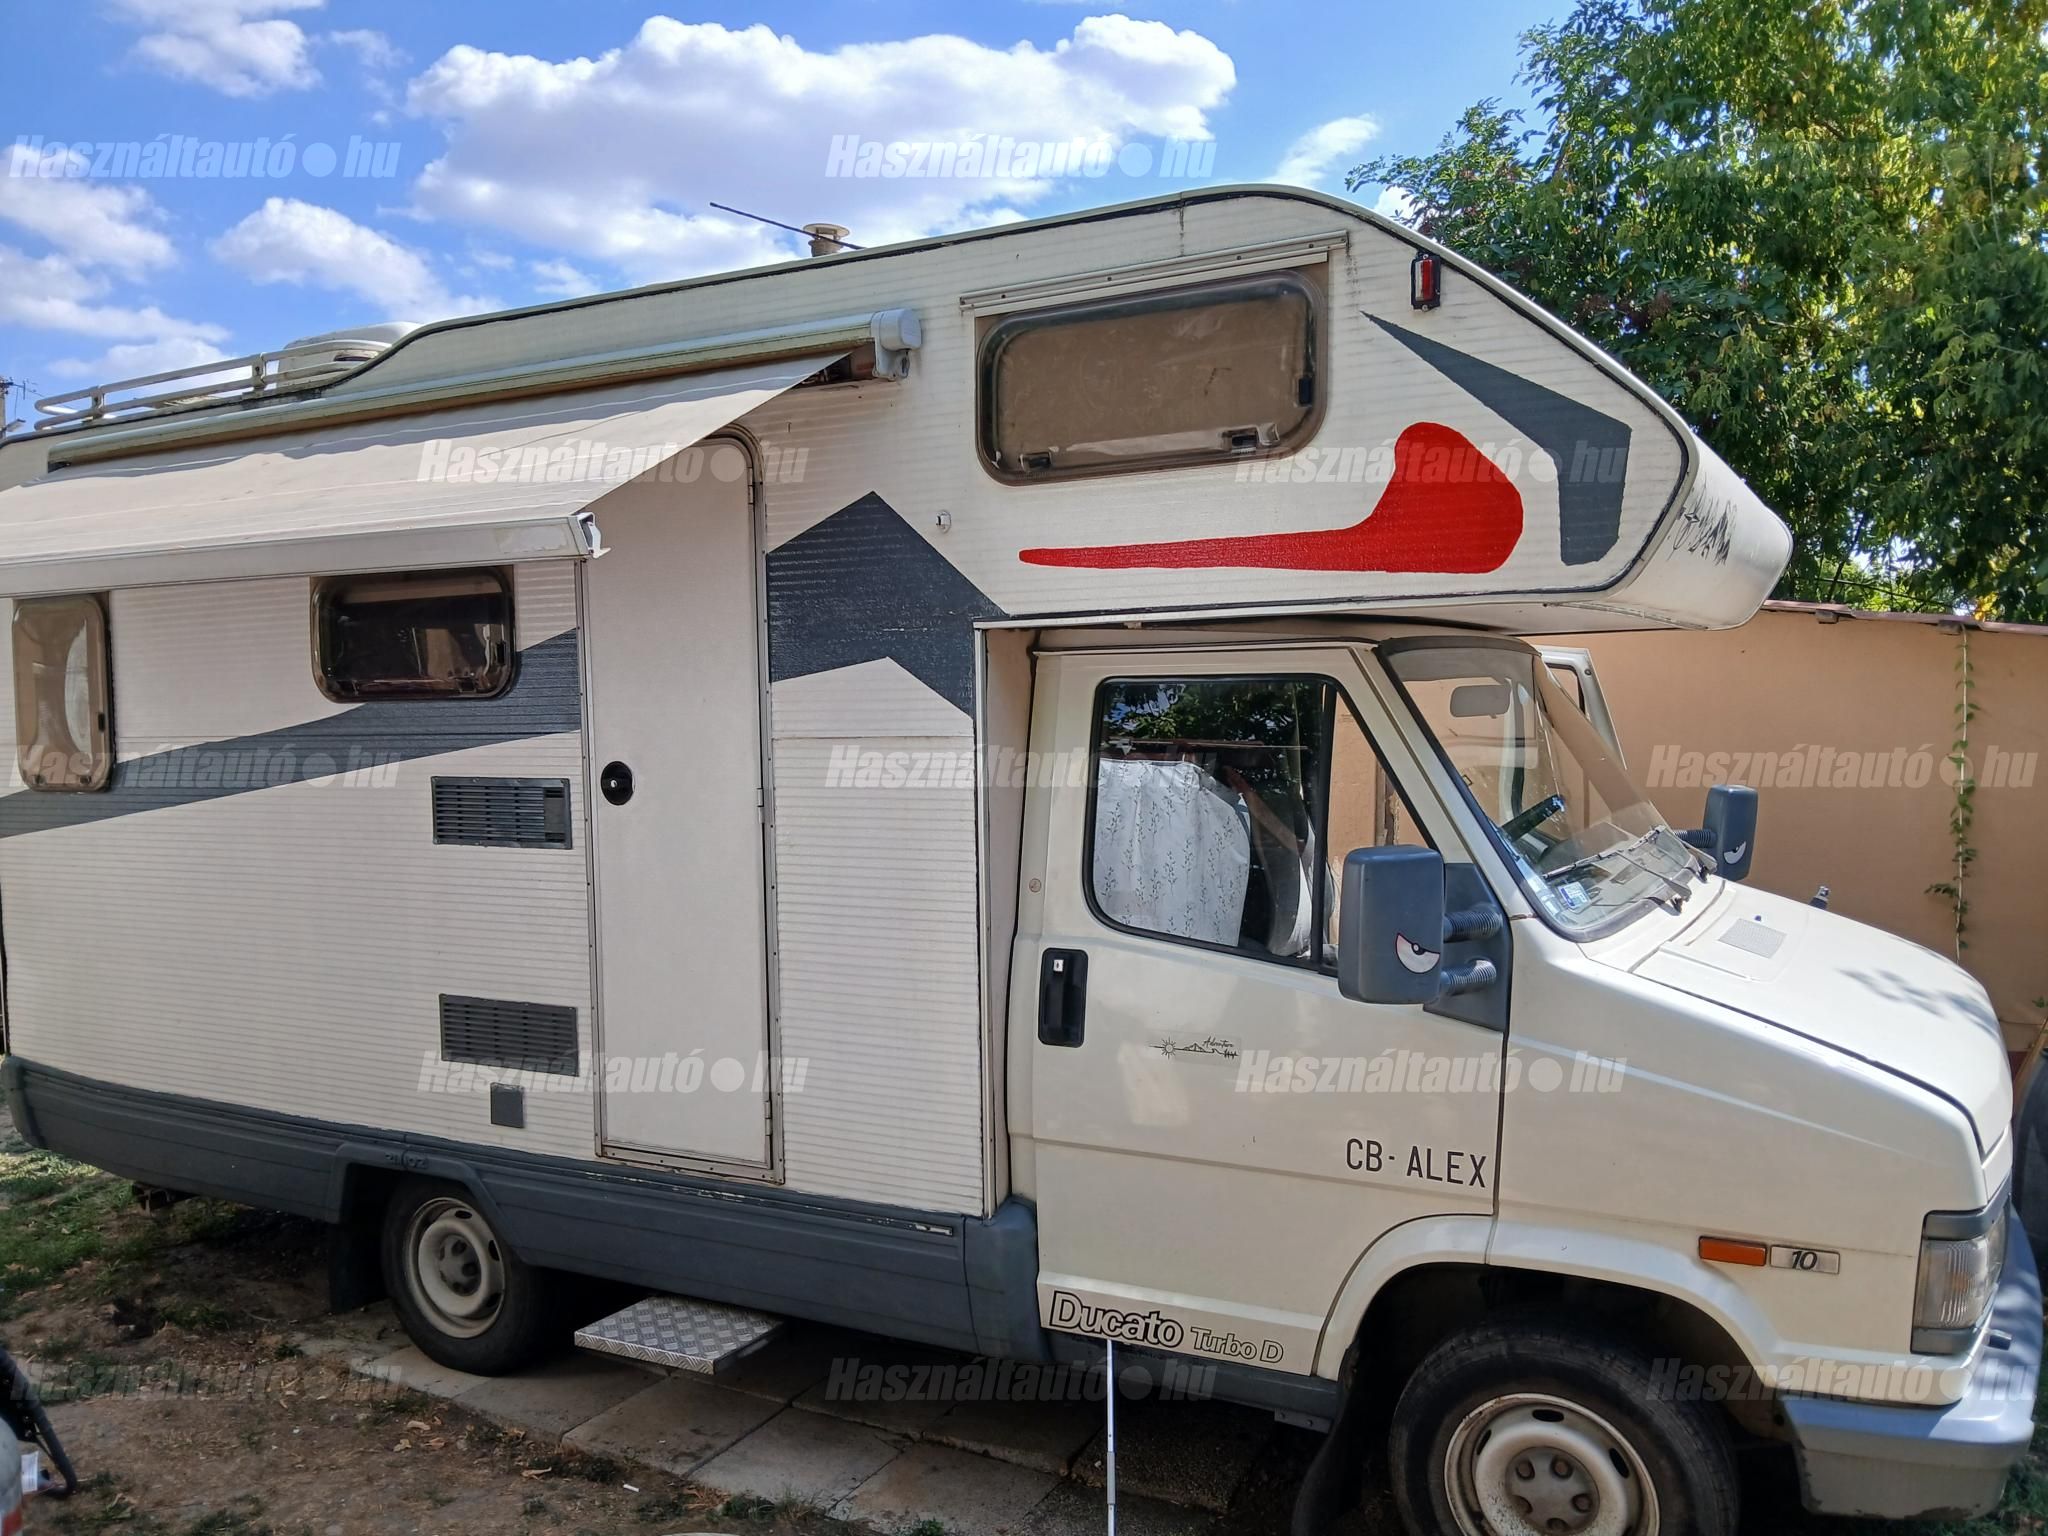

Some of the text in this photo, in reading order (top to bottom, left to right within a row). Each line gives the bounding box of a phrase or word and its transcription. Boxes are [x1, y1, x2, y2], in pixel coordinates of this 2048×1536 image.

[1406, 1145, 1487, 1188] ALEX
[1792, 1250, 1818, 1270] 10
[1050, 1290, 1284, 1364] Ducato Turbo D
